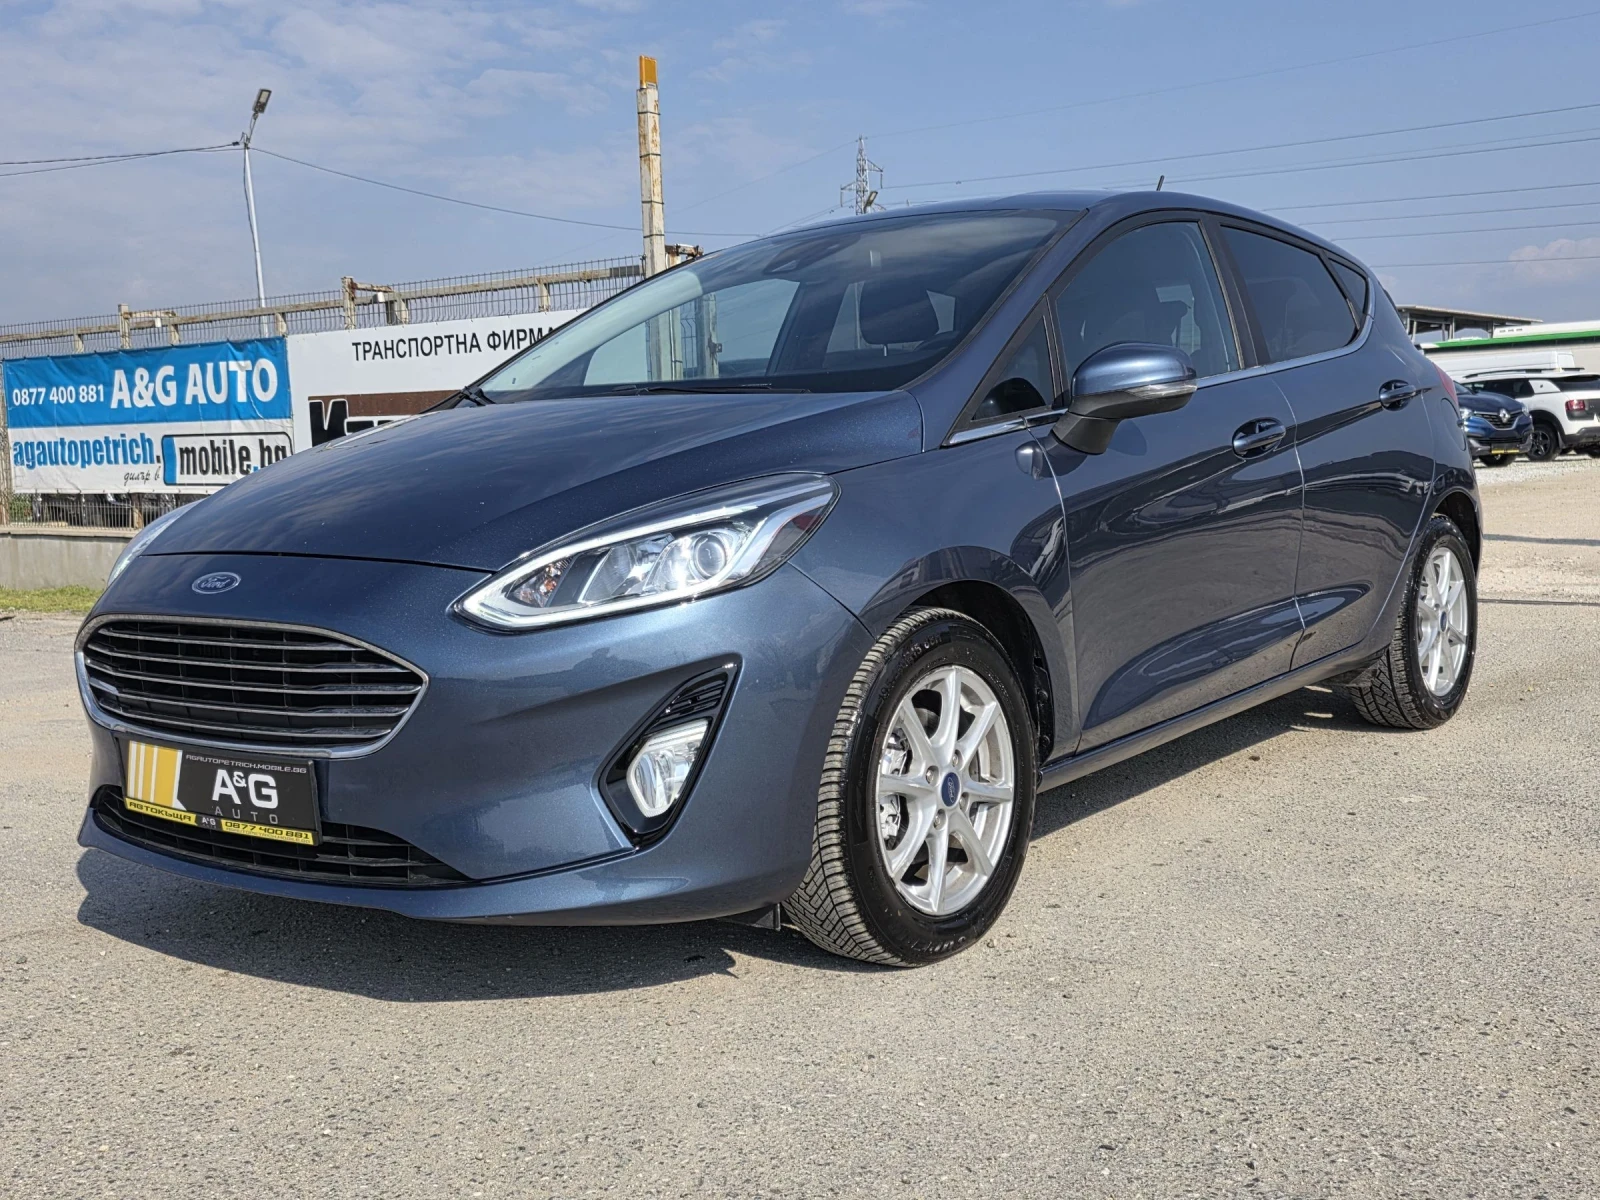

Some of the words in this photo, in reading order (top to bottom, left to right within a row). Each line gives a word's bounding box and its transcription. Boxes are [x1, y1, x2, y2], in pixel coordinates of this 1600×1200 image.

[351, 332, 482, 361] ТРАНСПОРТНА
[486, 326, 554, 352] ФИРМ
[12, 387, 46, 407] 0877
[49, 385, 76, 405] 400
[79, 383, 105, 403] 881
[110, 364, 177, 409] A&G
[185, 357, 278, 405] AUTO
[212, 768, 279, 809] A&G
[214, 806, 279, 825] AUTO
[225, 821, 256, 831] 0877
[259, 826, 283, 836] 400
[286, 830, 310, 840] 881
